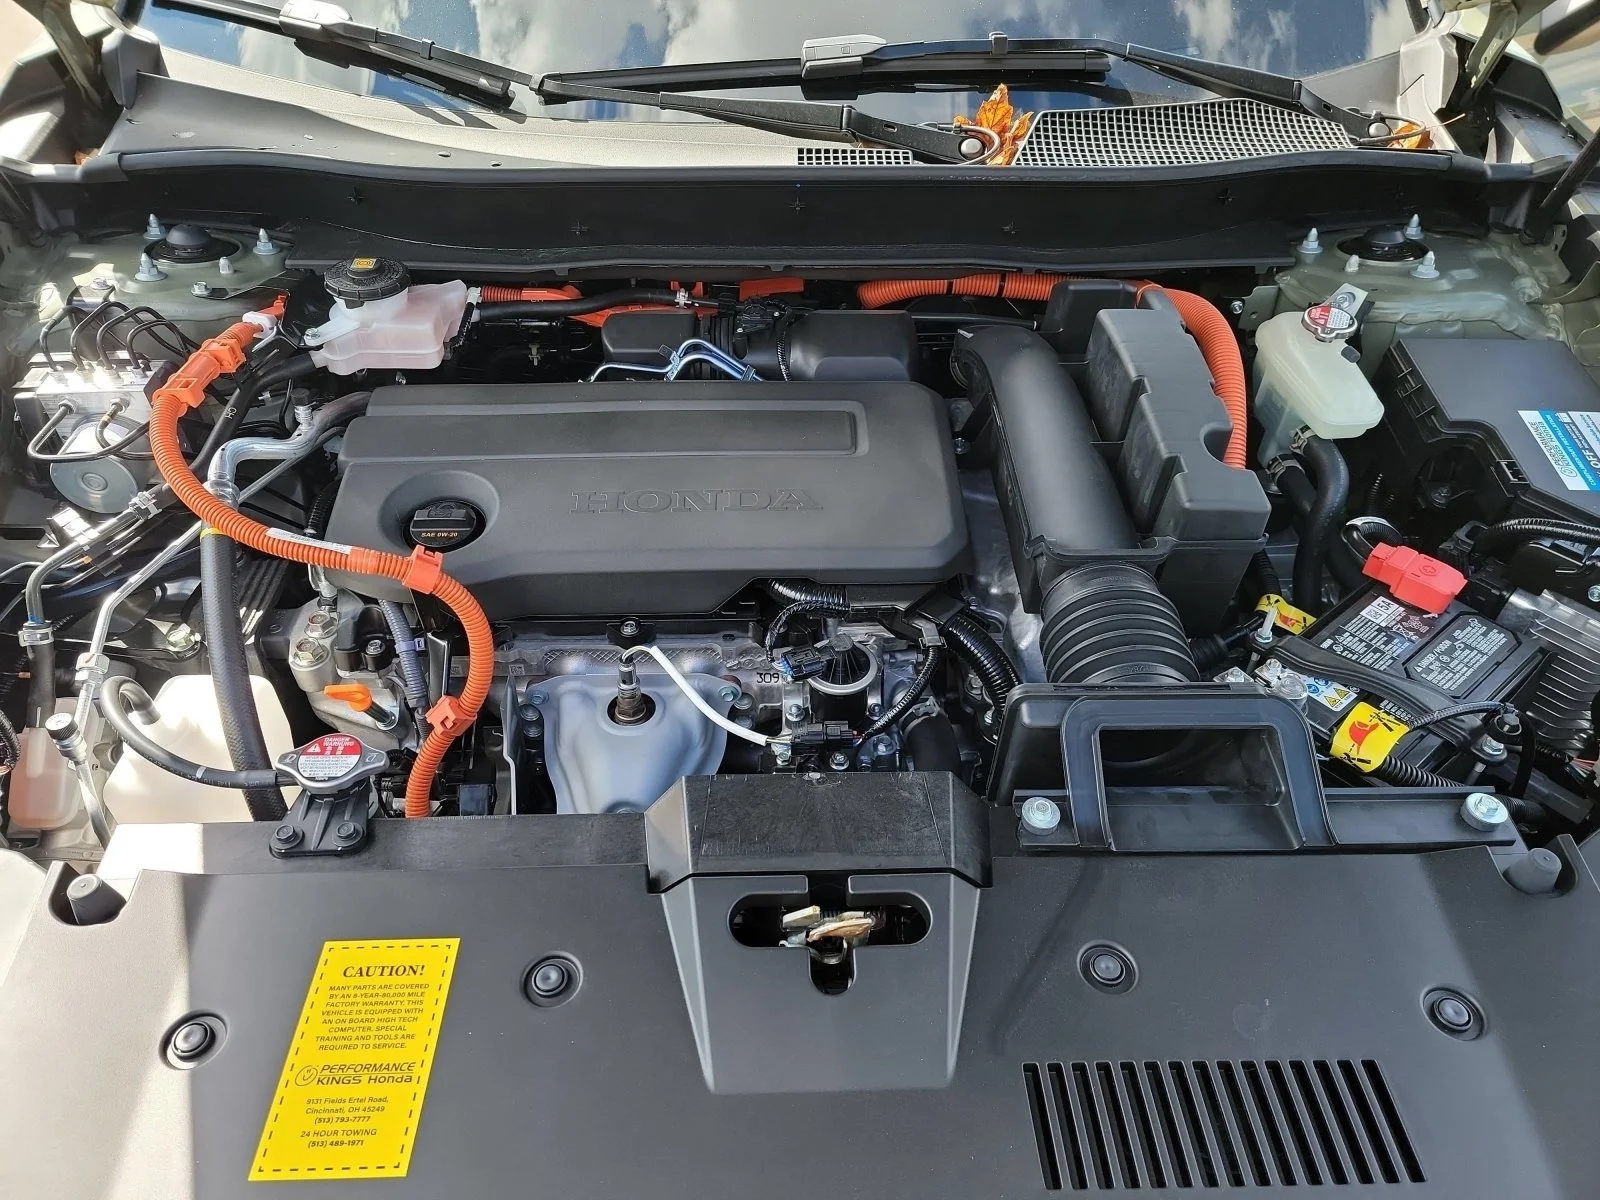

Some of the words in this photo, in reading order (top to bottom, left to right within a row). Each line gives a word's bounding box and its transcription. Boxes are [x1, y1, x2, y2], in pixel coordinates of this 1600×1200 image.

[1536, 421, 1555, 442] Honda
[1527, 421, 1562, 465] PERFORMANCE
[1552, 444, 1571, 466] KINGS
[1581, 449, 1600, 468] OFF
[570, 488, 824, 514] HONDA
[1377, 600, 1394, 610] 5A
[756, 672, 780, 683] 309
[343, 965, 425, 978] CAUTION!
[320, 1062, 416, 1074] PERFORMANCE
[316, 1076, 362, 1085] KINGS
[368, 1075, 412, 1084] Honda
[315, 1117, 333, 1125] (513)
[308, 1140, 327, 1148] (513)
